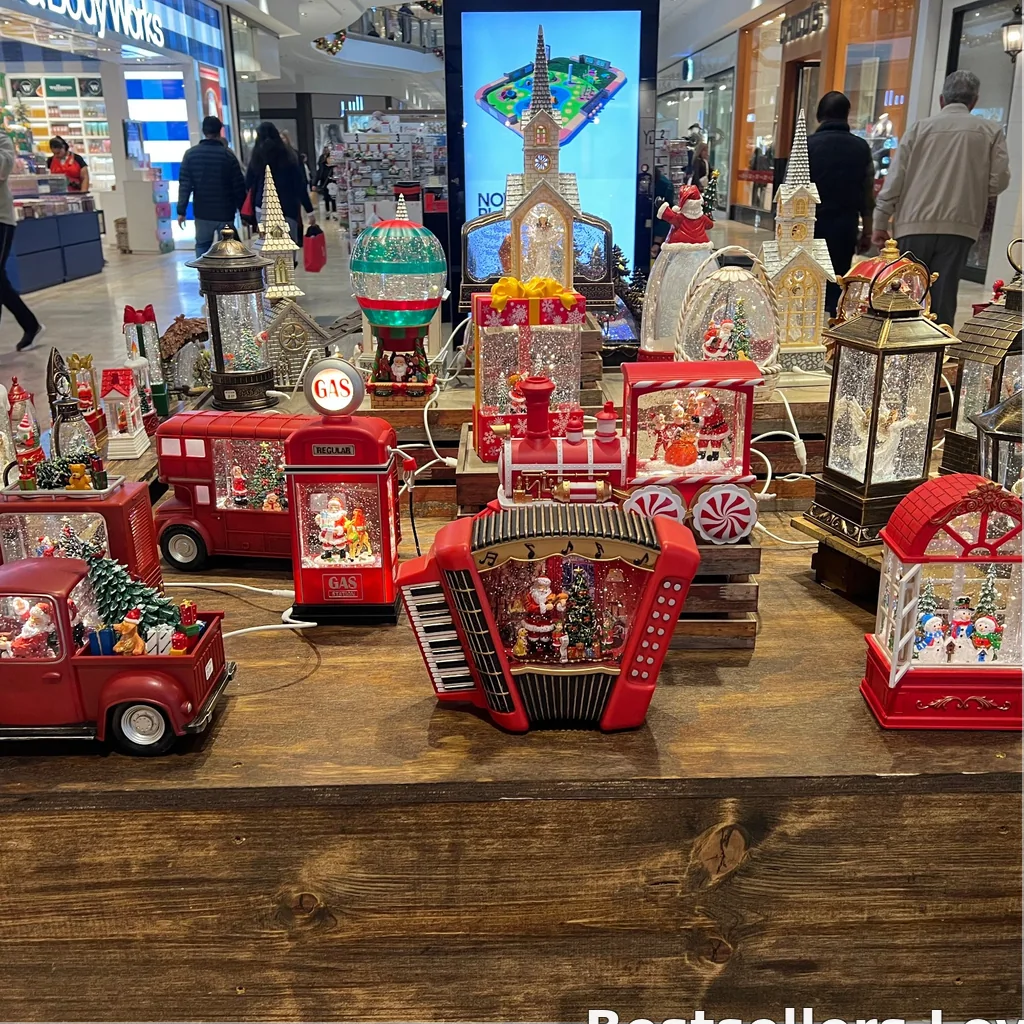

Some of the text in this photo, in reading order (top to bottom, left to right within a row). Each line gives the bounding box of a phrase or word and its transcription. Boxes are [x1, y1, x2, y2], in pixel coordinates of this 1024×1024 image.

[105, 0, 164, 47] Works
[477, 192, 506, 207] NO
[314, 378, 351, 398] GAS
[316, 446, 351, 455] REGULAR
[328, 576, 357, 590] GAS
